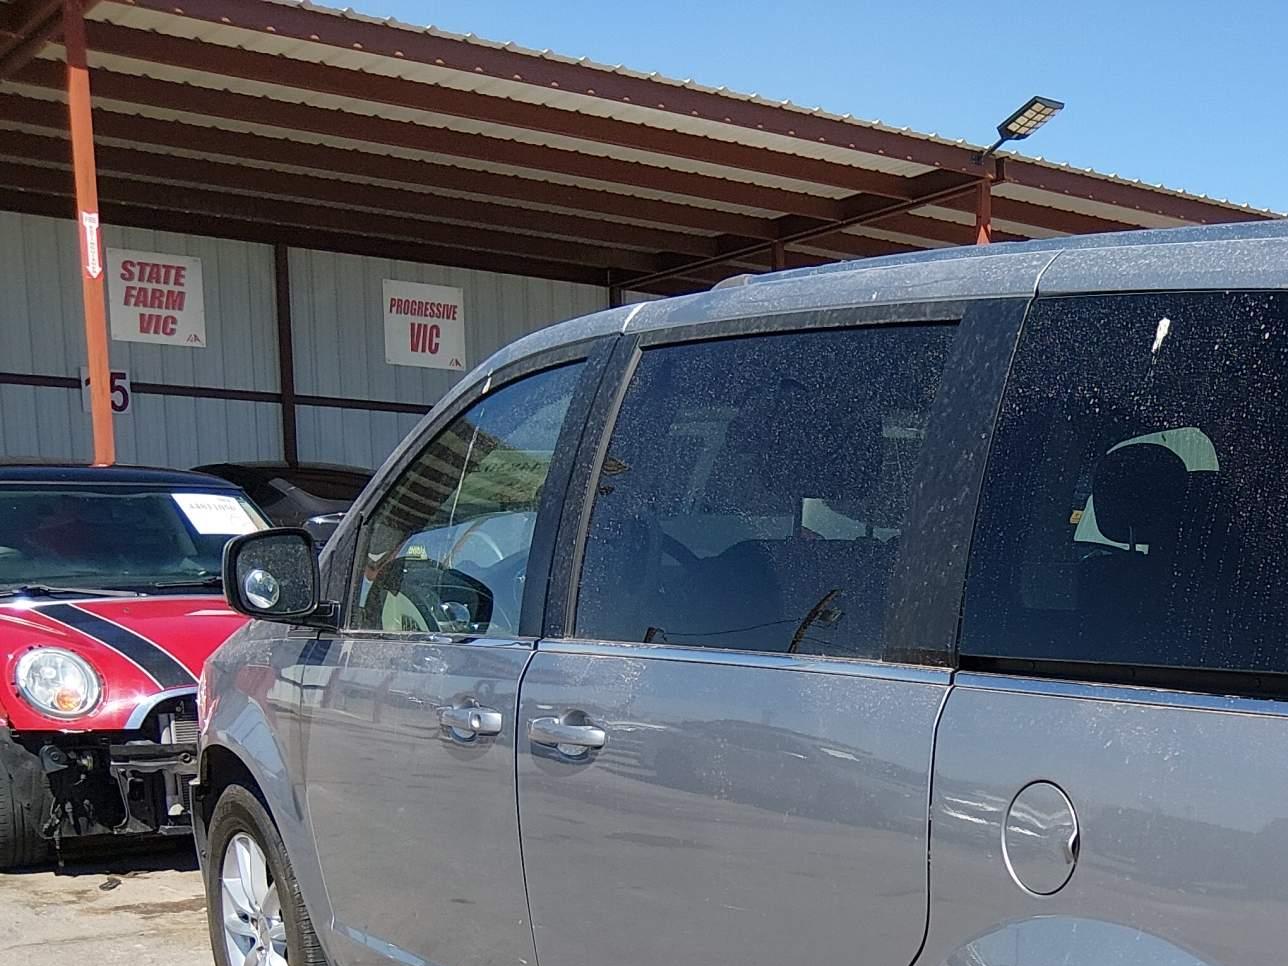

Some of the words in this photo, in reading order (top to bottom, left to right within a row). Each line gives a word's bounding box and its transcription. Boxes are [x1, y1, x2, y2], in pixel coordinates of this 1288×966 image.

[120, 260, 186, 287] STATE
[123, 286, 186, 311] FARM
[389, 298, 458, 320] PROGRESSIVE
[139, 313, 177, 336] VIC
[410, 322, 441, 355] VIC
